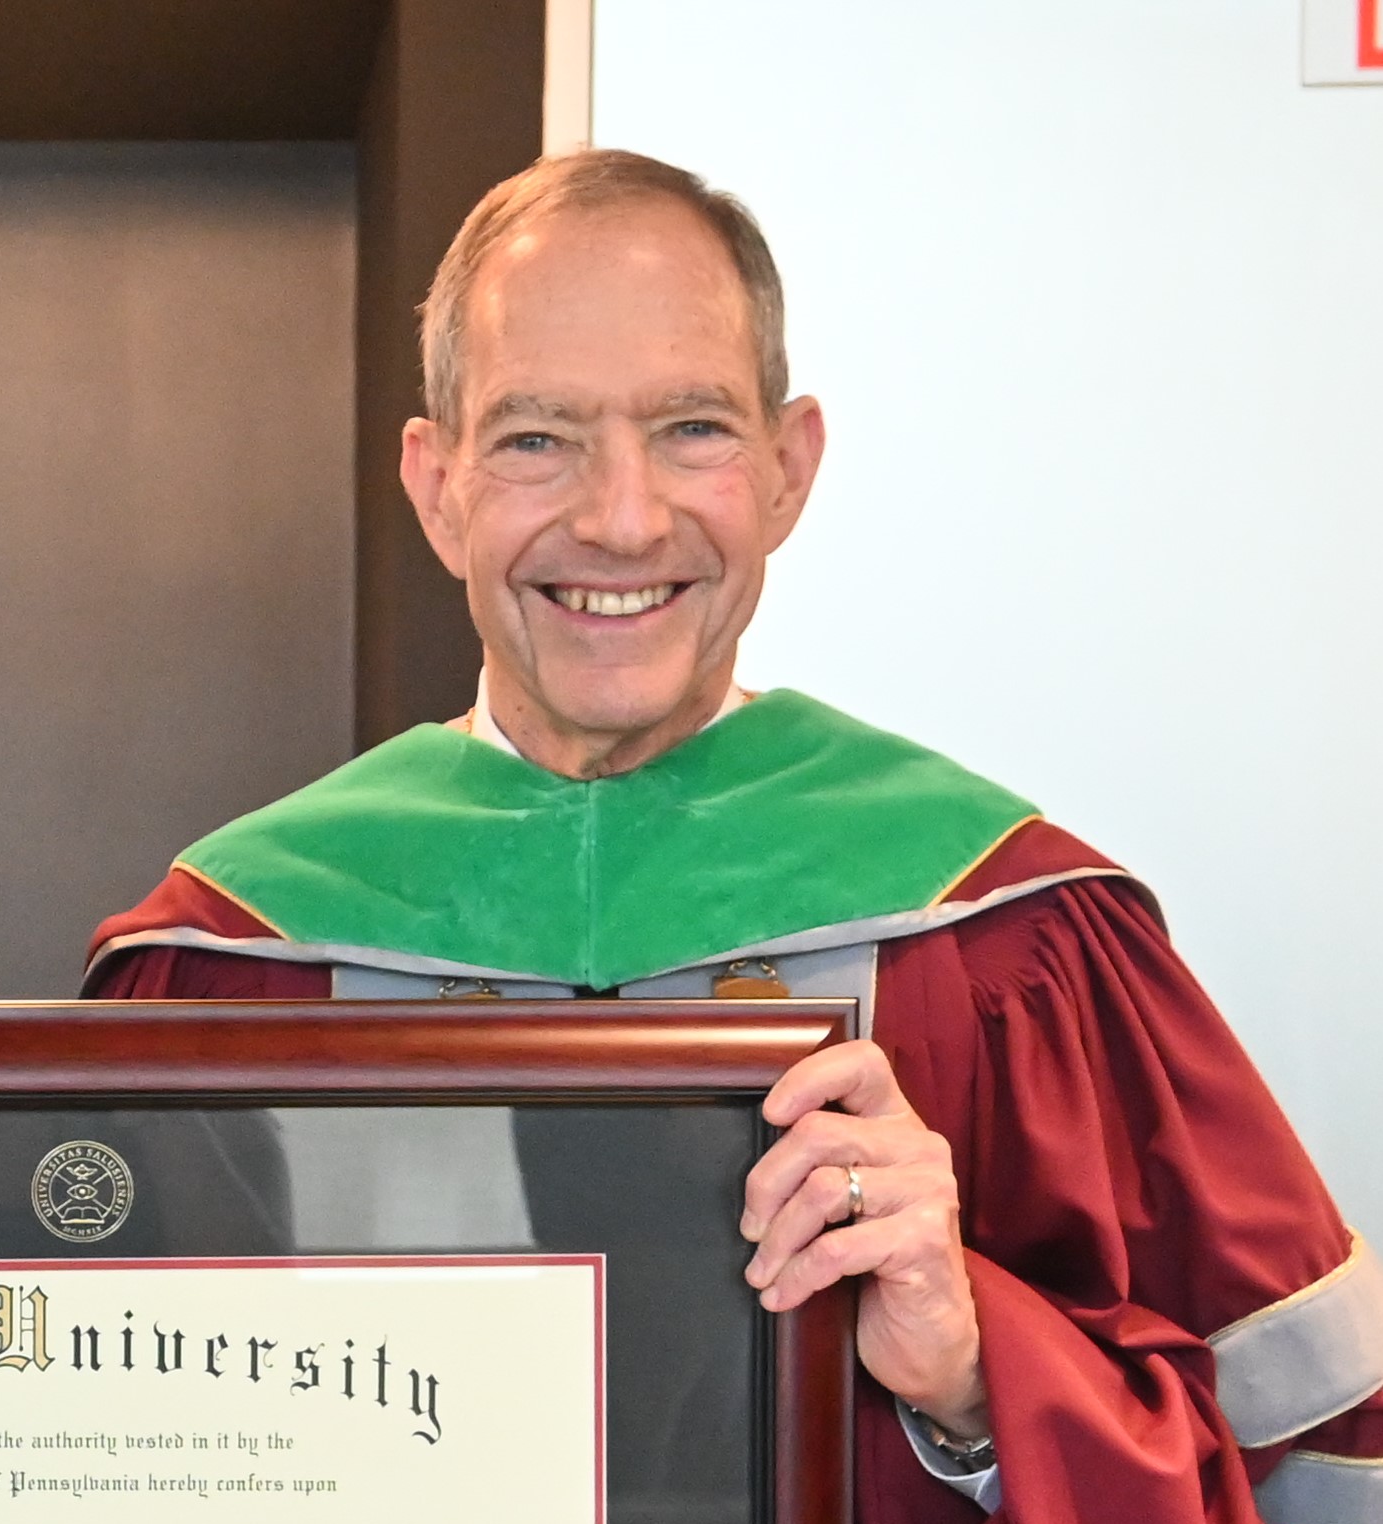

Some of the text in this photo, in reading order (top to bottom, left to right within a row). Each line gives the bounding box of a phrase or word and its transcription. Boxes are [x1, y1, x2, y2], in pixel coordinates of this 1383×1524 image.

[38, 1148, 127, 1217] UNIVERSITAS SALUSIENSIS
[31, 1430, 118, 1457] authority
[125, 1432, 184, 1450] vested
[192, 1432, 209, 1450] in
[217, 1432, 229, 1450] it
[237, 1431, 260, 1458] by
[267, 1431, 294, 1450] the
[9, 1469, 139, 1500] Pennsylvania
[148, 1472, 209, 1499] hereby
[216, 1472, 285, 1492] confers
[292, 1479, 337, 1497] upon
